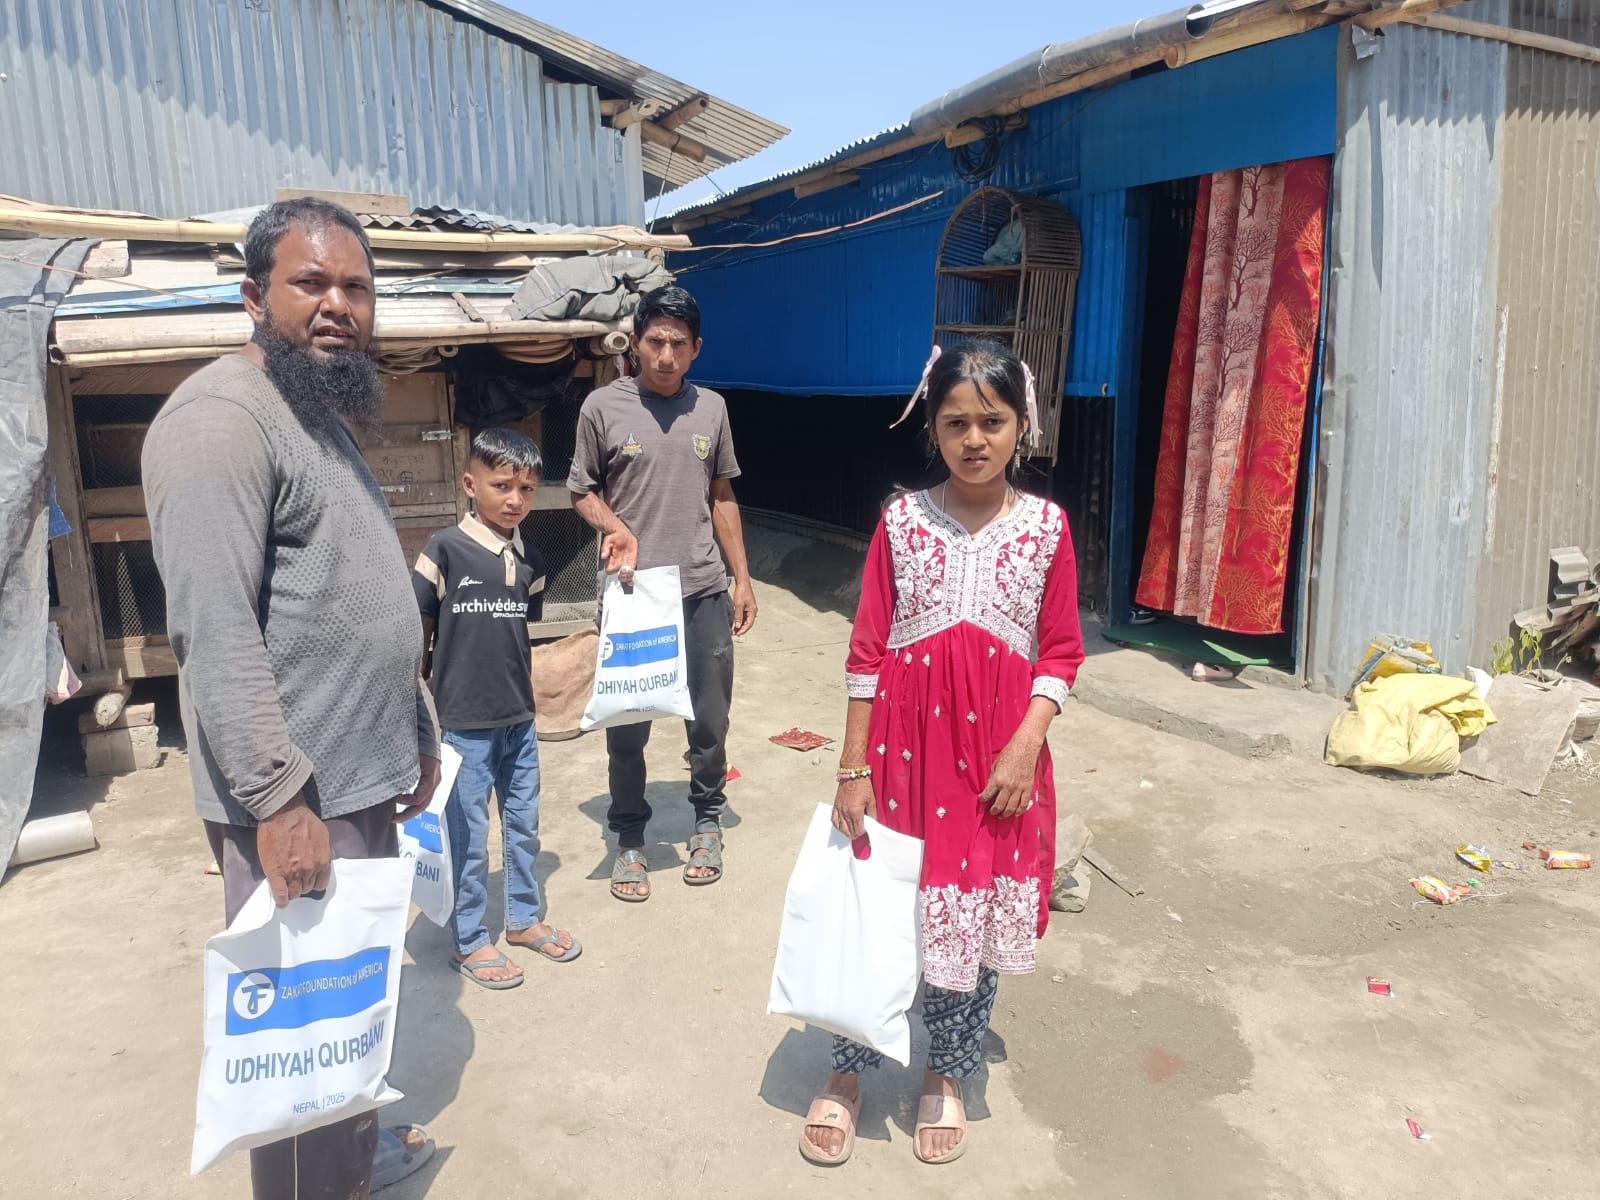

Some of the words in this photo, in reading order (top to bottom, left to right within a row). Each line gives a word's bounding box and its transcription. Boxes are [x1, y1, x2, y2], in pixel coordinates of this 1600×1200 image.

[597, 679, 638, 695] DHIYAH
[281, 983, 303, 999] ZAKAT
[303, 975, 352, 994] FOUNDATION
[351, 973, 358, 985] of
[357, 961, 383, 981] AMERICA
[225, 1047, 314, 1085] UDHIYAH
[318, 1019, 385, 1068] QURBANI
[292, 1100, 321, 1114] NEPAL
[326, 1092, 346, 1107] 2025
